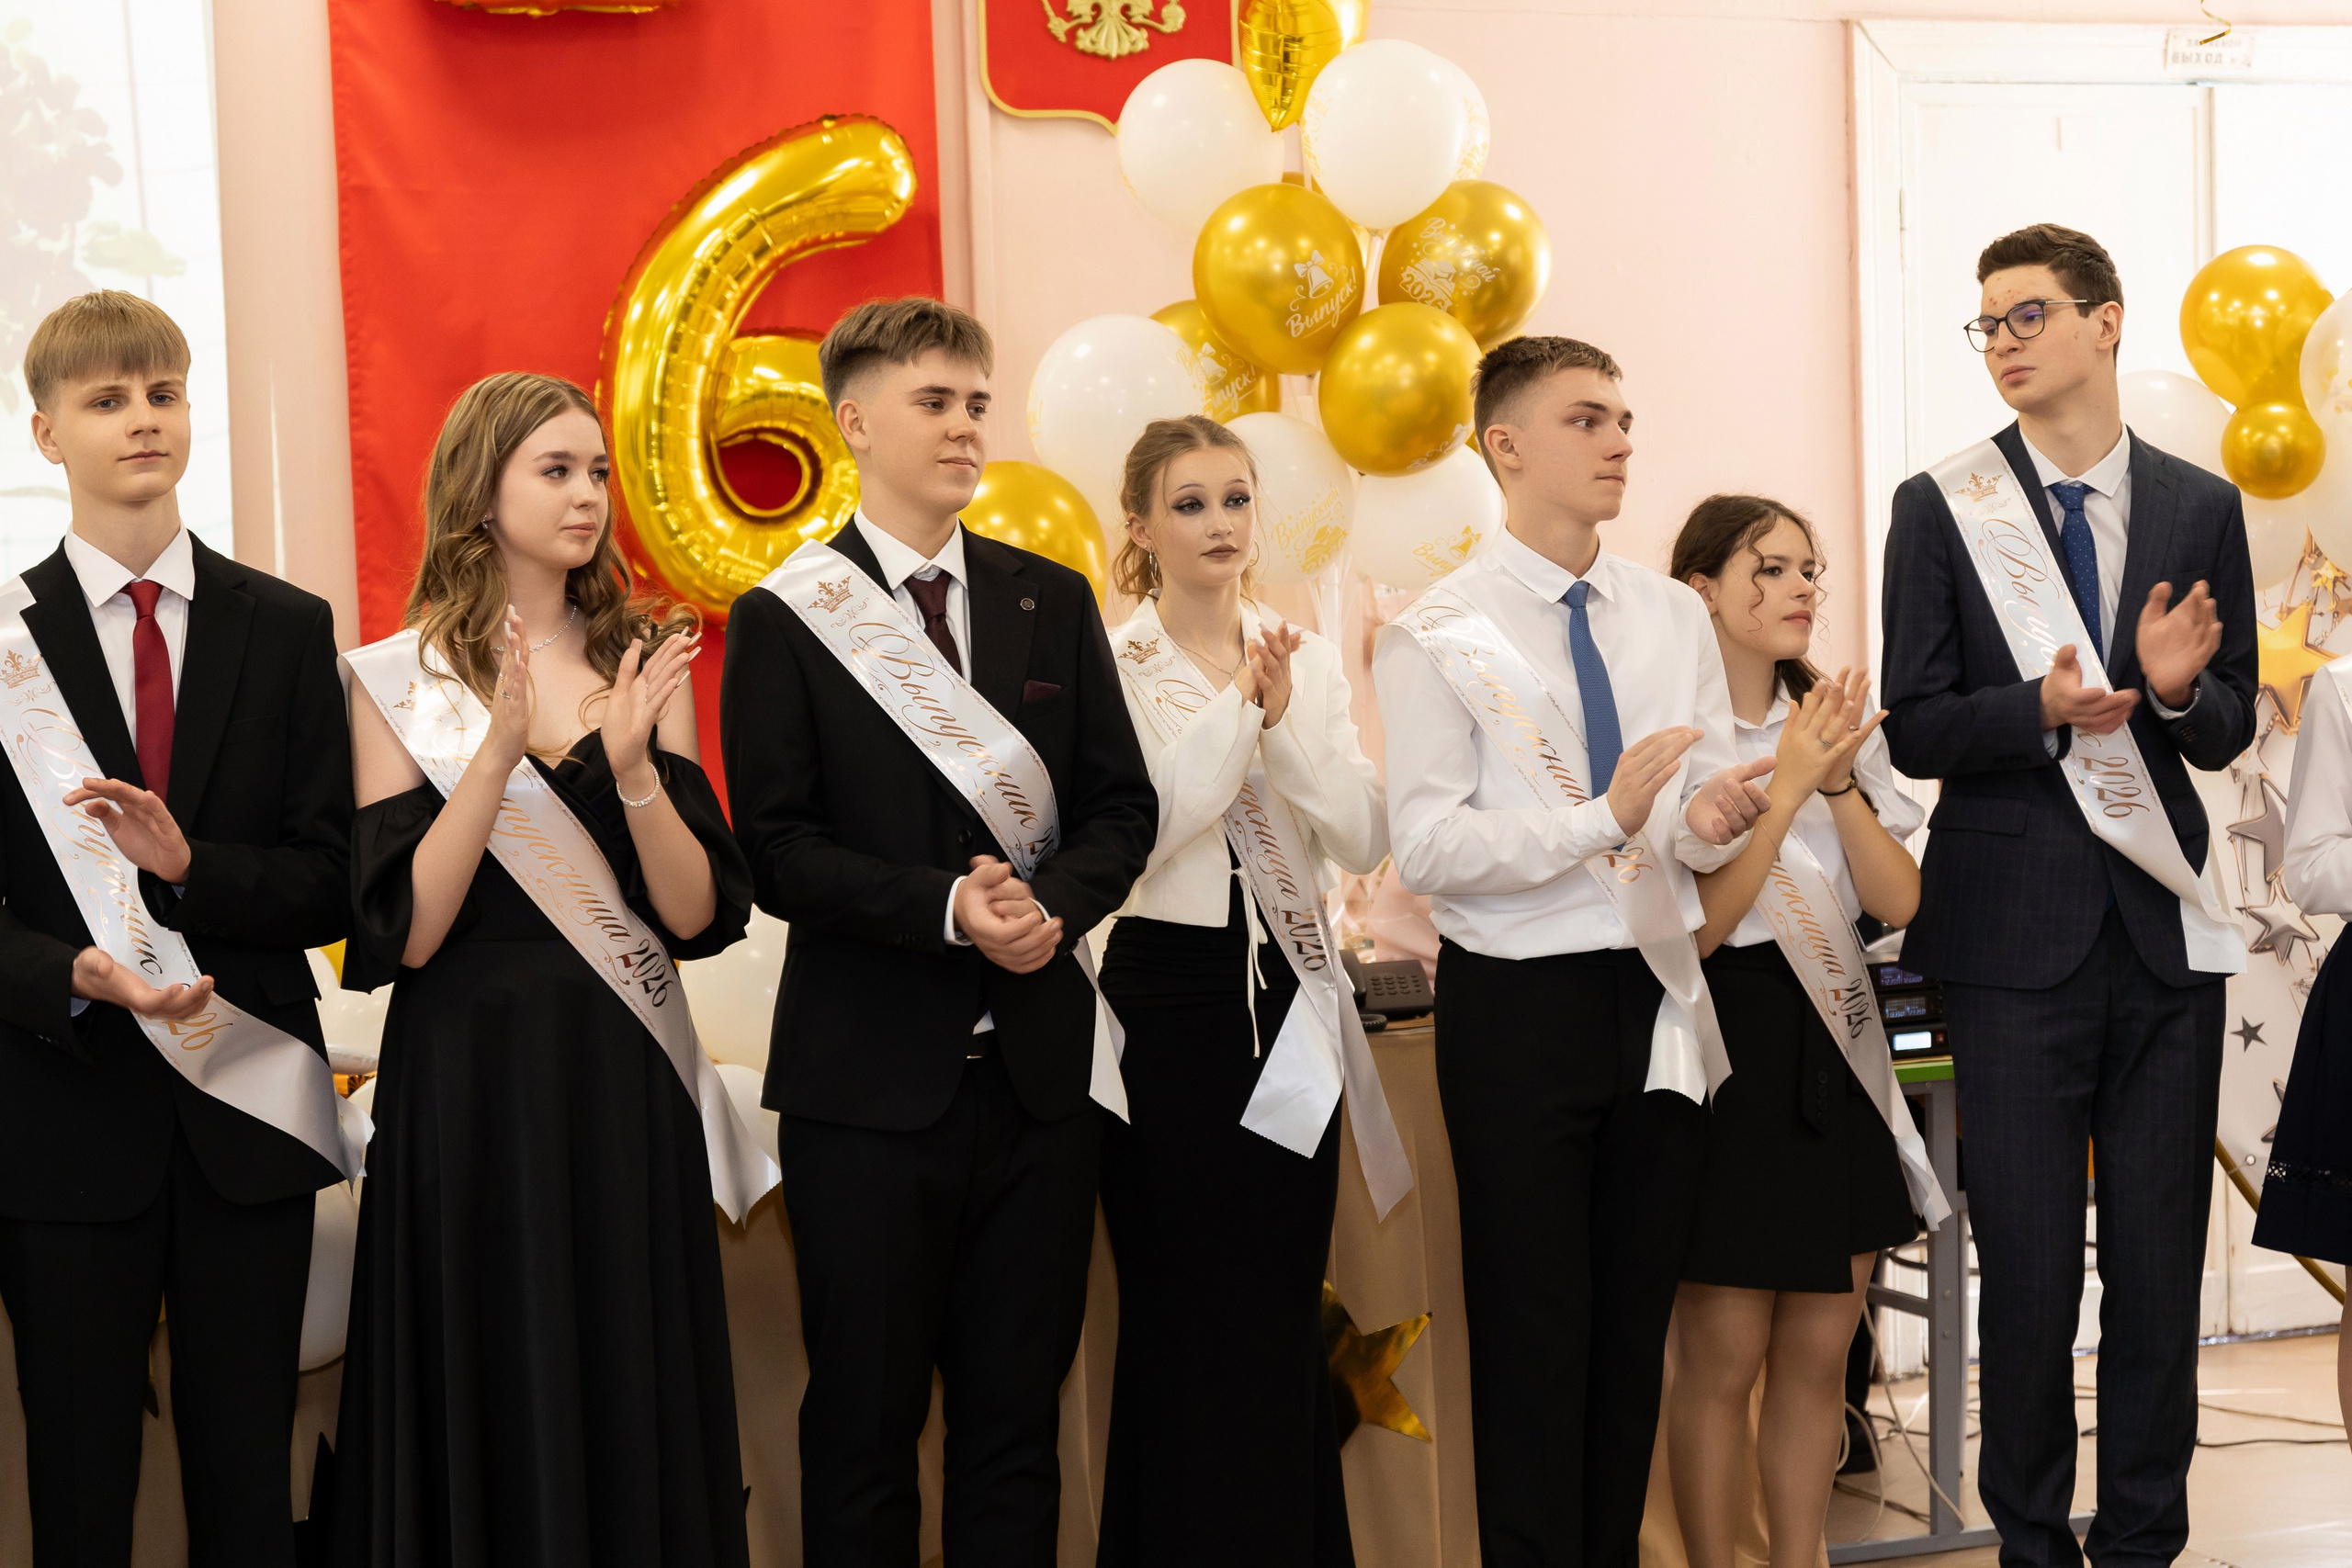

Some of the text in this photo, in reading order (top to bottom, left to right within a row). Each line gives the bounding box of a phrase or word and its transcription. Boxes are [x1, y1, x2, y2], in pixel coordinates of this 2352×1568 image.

[2172, 51, 2223, 64] ВЫХОД
[1285, 265, 1357, 338] Выпуск!
[1212, 364, 1258, 414] пуск!
[848, 621, 1057, 864] Выпускник 20
[2078, 756, 2151, 818] 2026
[1601, 835, 1653, 884] 26
[1281, 908, 1328, 972] 2026
[616, 938, 674, 1009] 2026
[1829, 977, 1872, 1040] 2026
